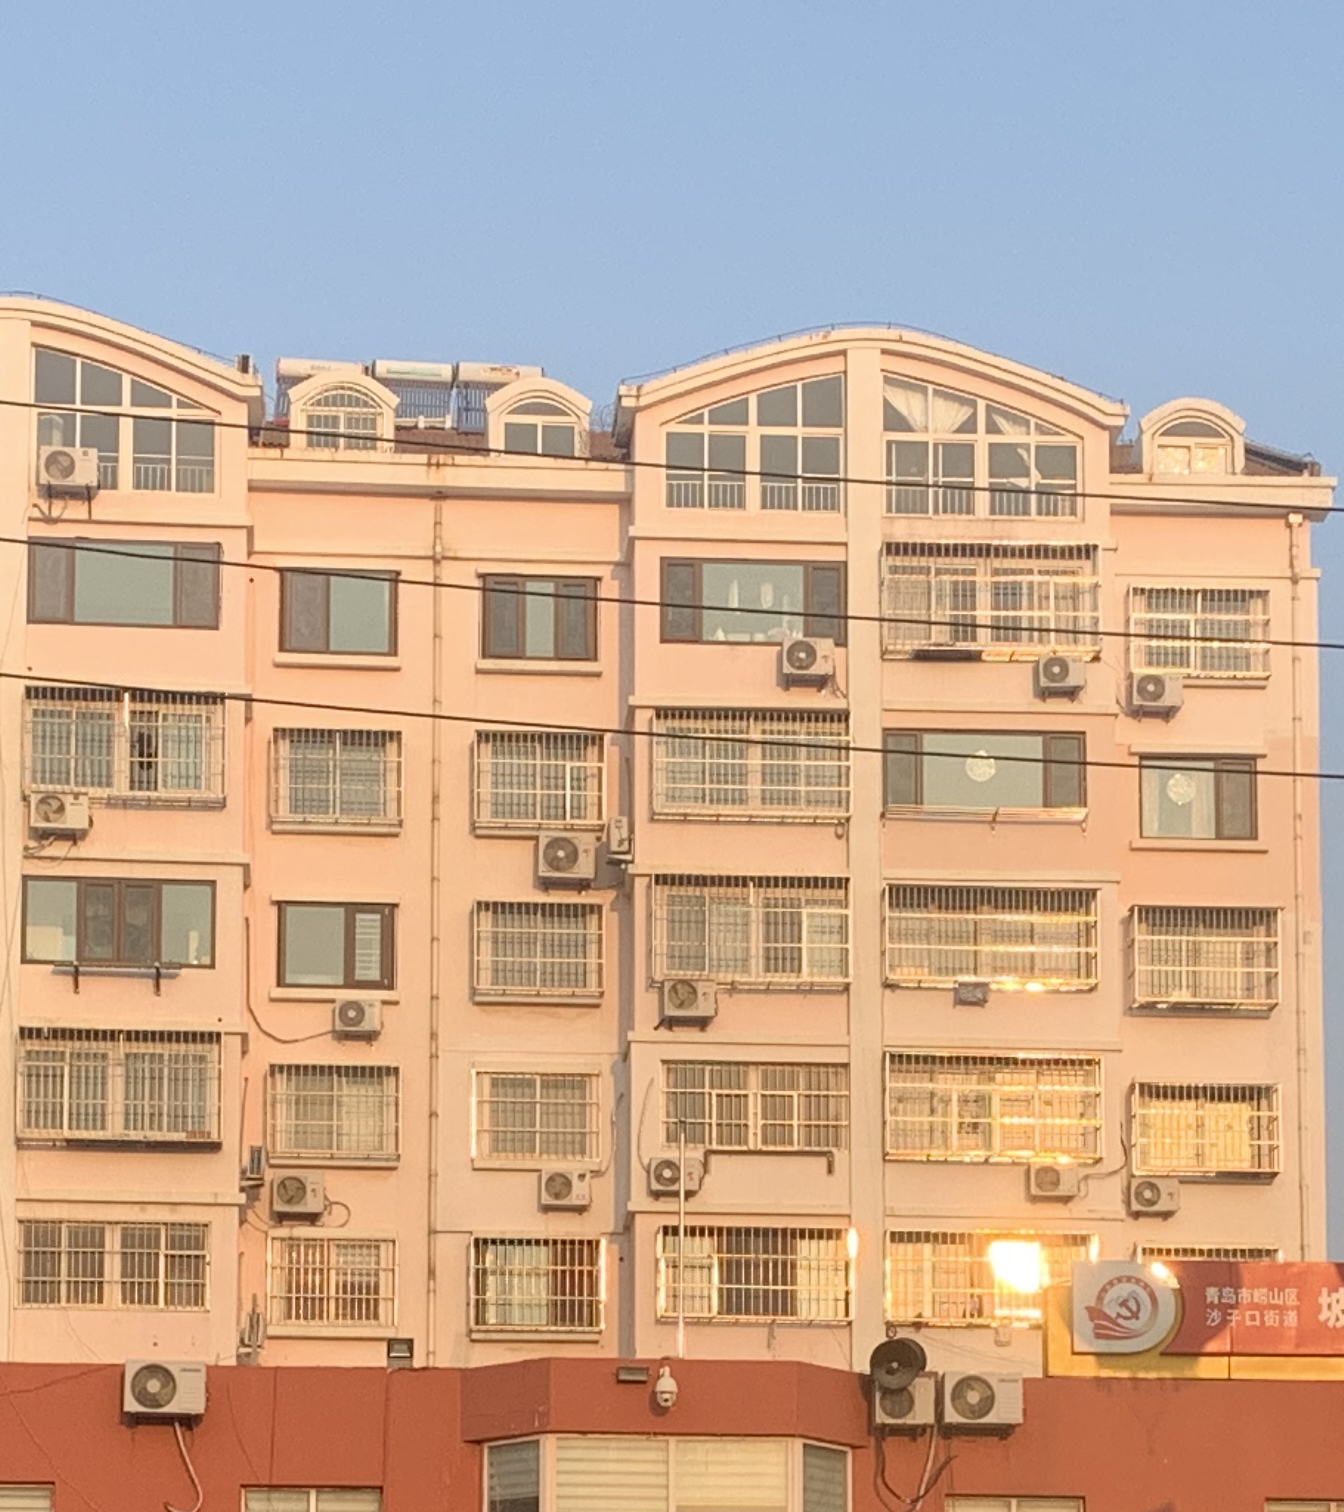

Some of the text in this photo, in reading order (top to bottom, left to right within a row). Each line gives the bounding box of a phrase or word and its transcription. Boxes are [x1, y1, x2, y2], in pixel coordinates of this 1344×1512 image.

[1205, 1286, 1300, 1305] 青岛市崂山区
[1205, 1308, 1299, 1327] 沙子口街道
